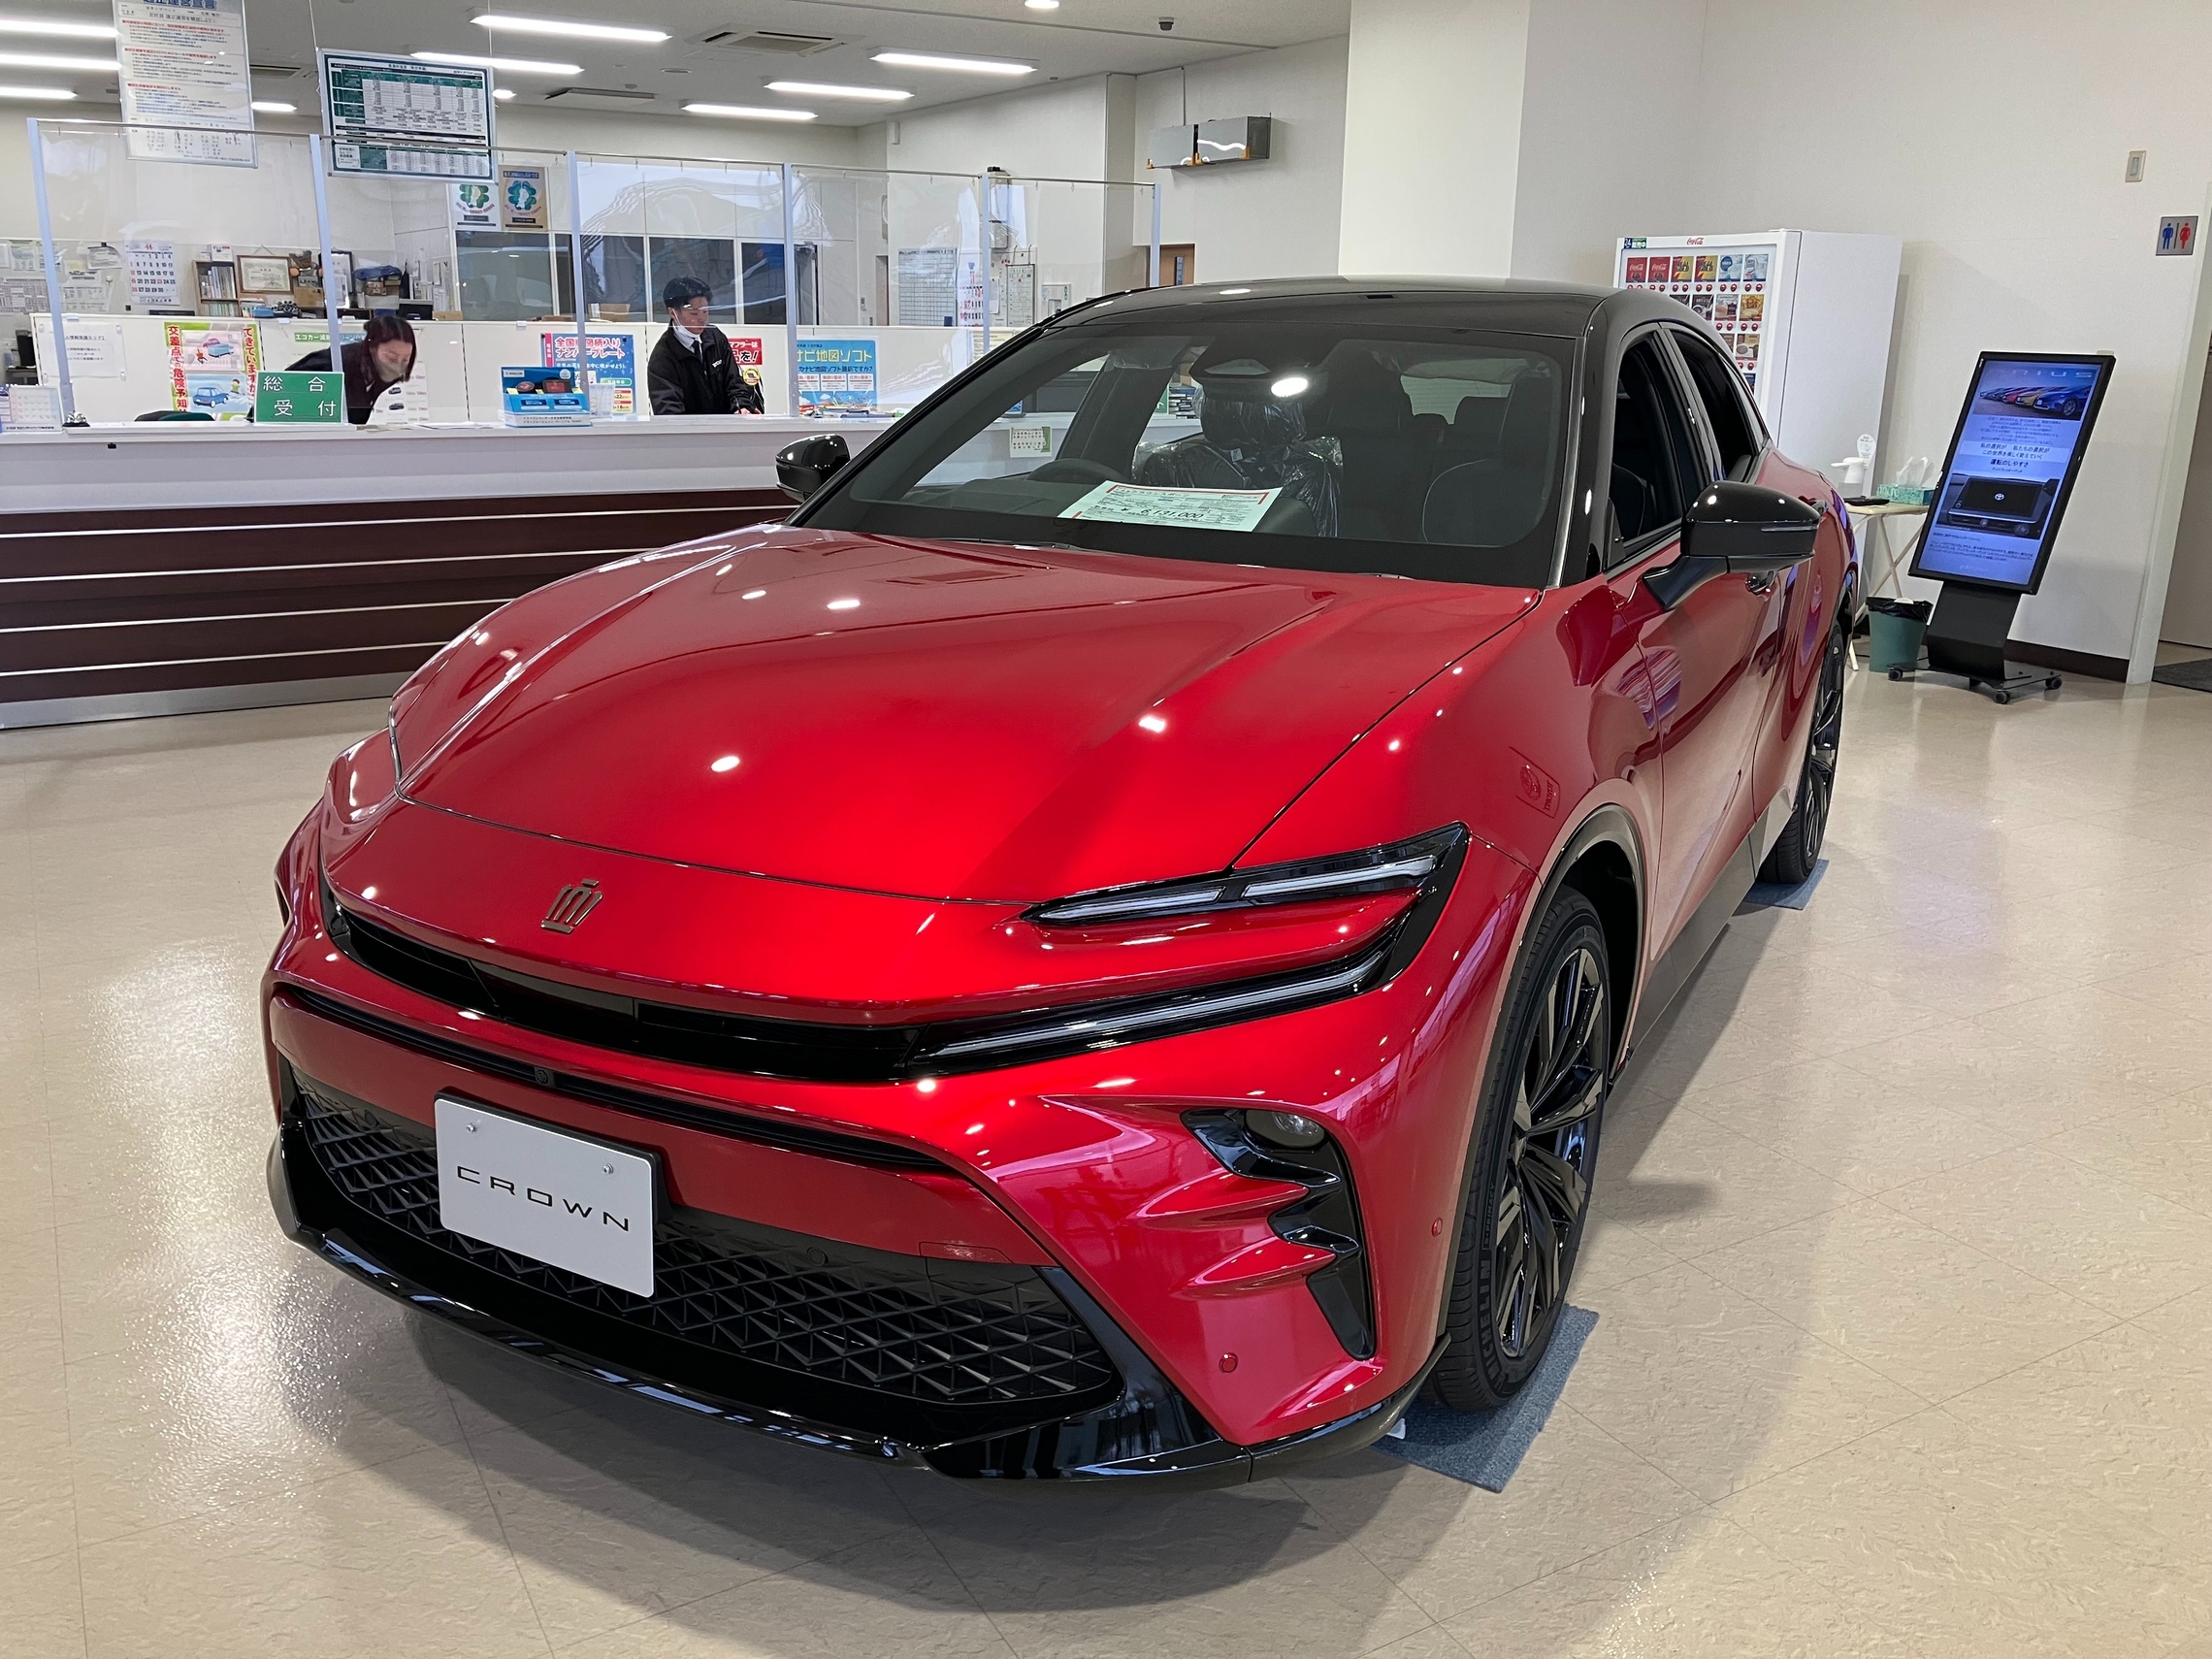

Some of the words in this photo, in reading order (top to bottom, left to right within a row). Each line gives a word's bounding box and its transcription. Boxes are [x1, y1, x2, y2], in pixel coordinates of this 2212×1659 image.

[555, 337, 620, 349] 全国図柄入り
[168, 325, 188, 411] 交差点での危険予知
[263, 375, 326, 391] 総合
[274, 399, 337, 417] 受付
[456, 1166, 629, 1232] CROWN
[1480, 1259, 1507, 1393] MICHELIN
